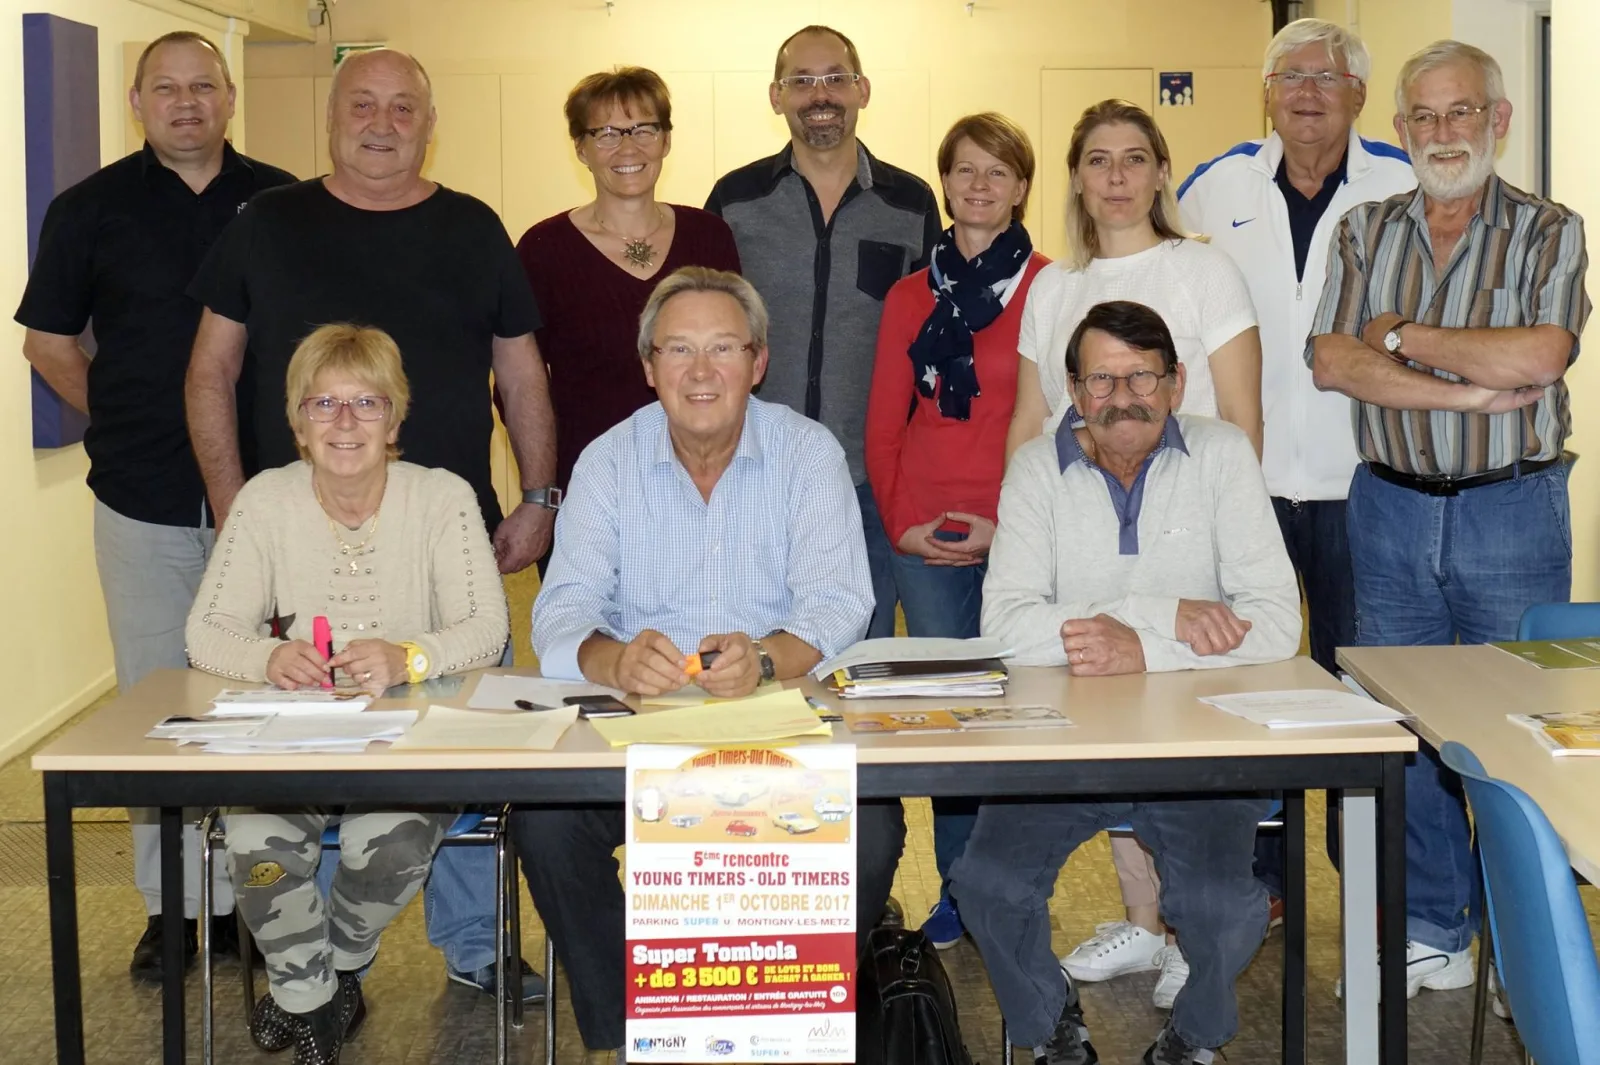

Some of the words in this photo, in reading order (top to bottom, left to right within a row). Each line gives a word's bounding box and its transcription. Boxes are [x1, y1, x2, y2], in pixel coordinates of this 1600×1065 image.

[766, 749, 793, 768] Timers
[723, 852, 790, 867] rencontre
[632, 871, 683, 886] YOUNG
[687, 871, 746, 886] TIMERS
[757, 871, 787, 886] OLD
[791, 871, 850, 886] TIMERS
[632, 894, 710, 911] DIMANCHE
[739, 893, 810, 911] OCTOBRE
[814, 893, 850, 911] 2017
[632, 918, 680, 926] PARKING
[684, 917, 719, 926] SUPER
[737, 917, 851, 926] MONTIGNY-LES-METZ
[632, 944, 697, 968] Super
[702, 940, 798, 963] Tombola
[634, 972, 648, 988] +
[649, 968, 677, 988] de
[746, 965, 759, 986] €
[764, 965, 777, 974] DE
[777, 965, 801, 974] LOTS
[802, 964, 815, 973] ET
[634, 994, 680, 1005] ANIMATION
[686, 992, 747, 1003] RESTAURATION
[787, 990, 828, 1000] GRATUITE
[750, 1049, 780, 1057] SUPER
